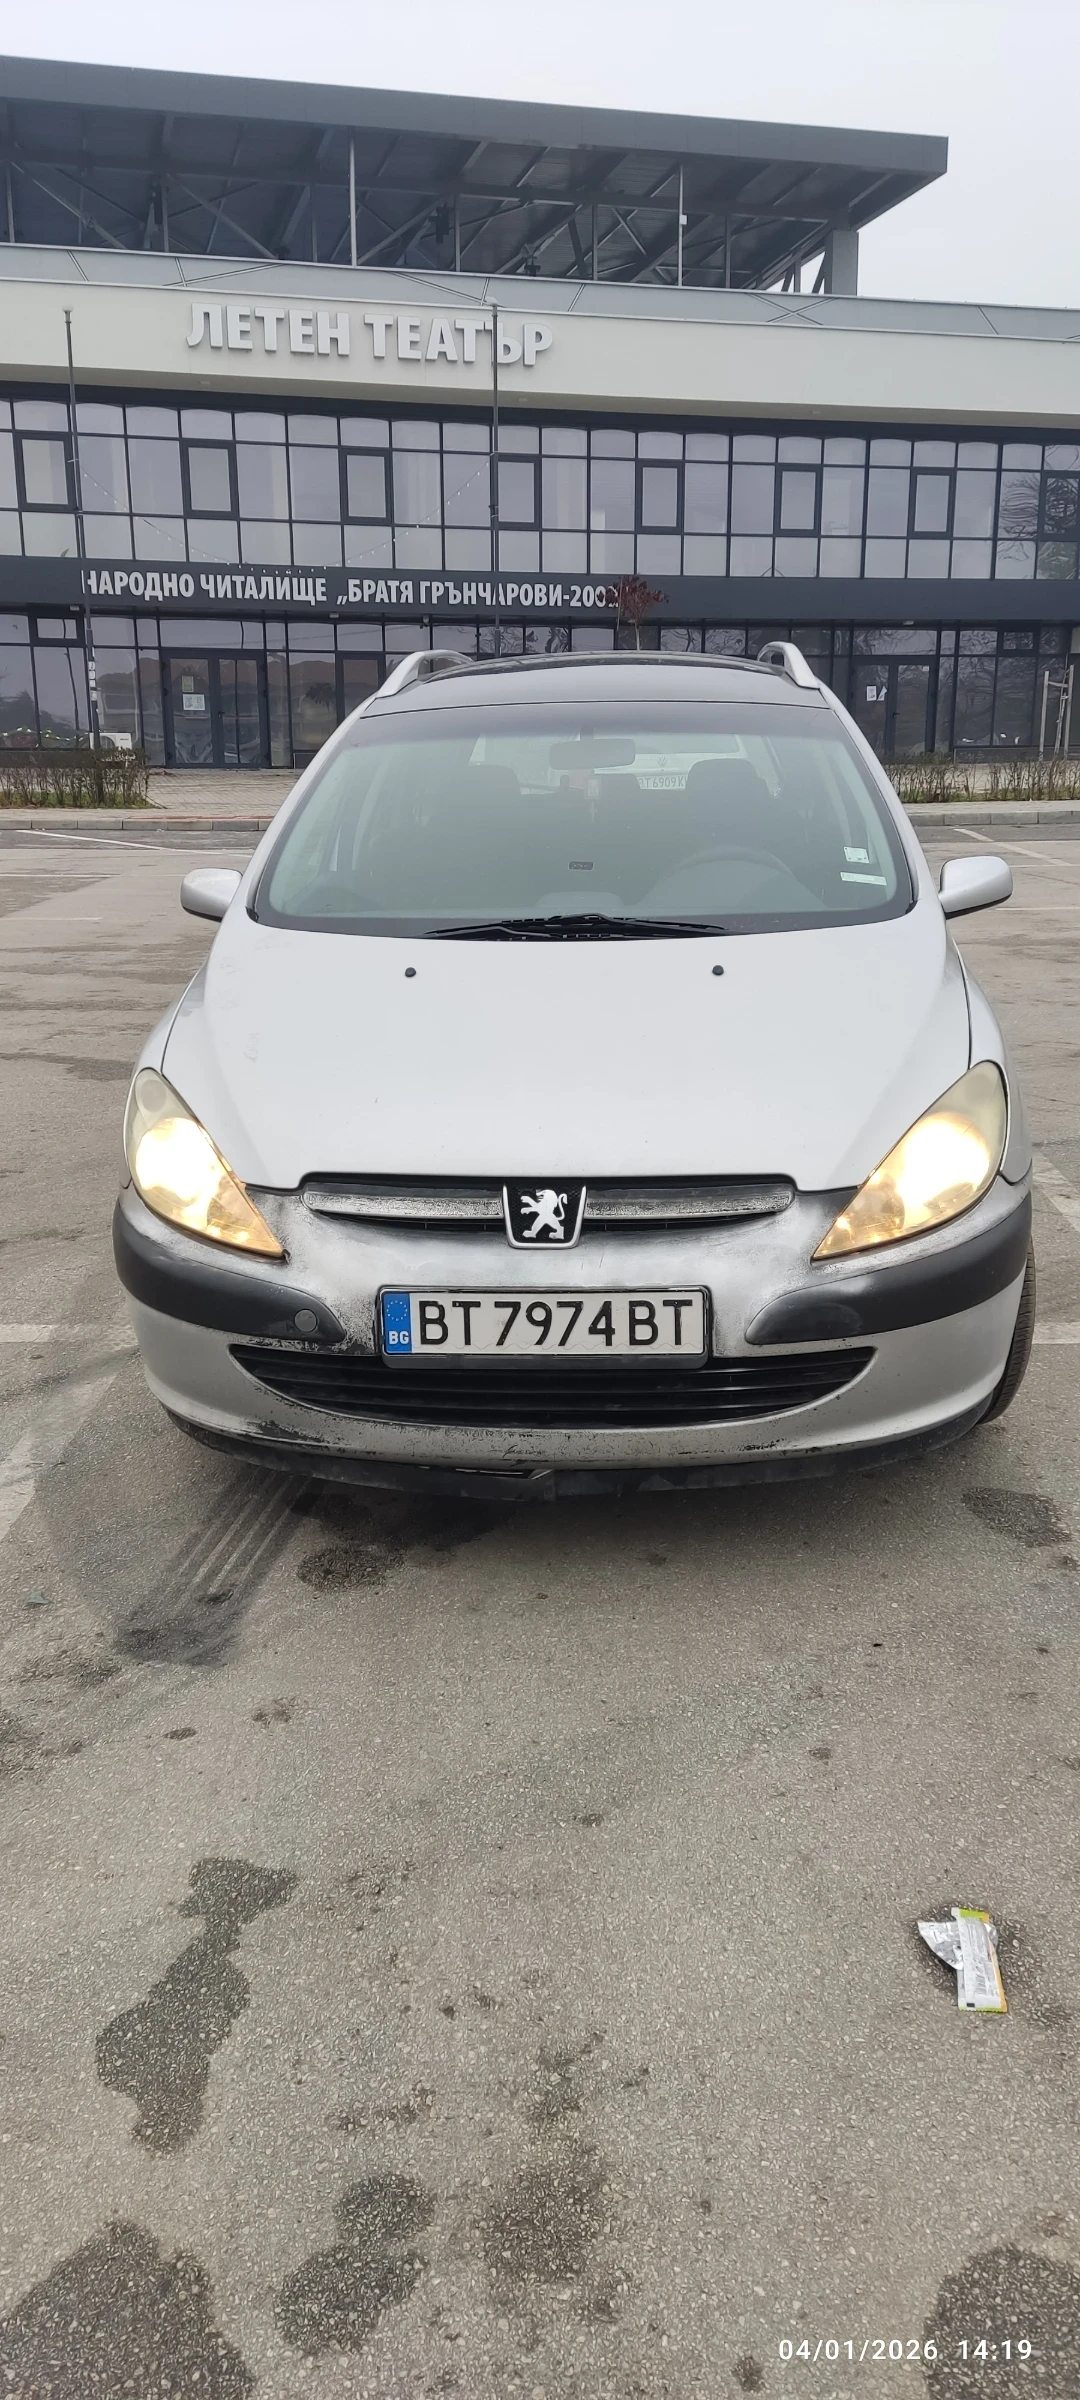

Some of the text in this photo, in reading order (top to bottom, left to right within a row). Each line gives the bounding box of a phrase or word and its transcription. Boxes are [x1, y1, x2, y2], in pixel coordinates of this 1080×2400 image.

[186, 302, 553, 366] ЛЕТЕН ТЕАТЪР
[81, 569, 195, 601] НАРОДНО
[200, 575, 327, 606] ЧИТАЛИЩЕ
[388, 1330, 410, 1345] BG
